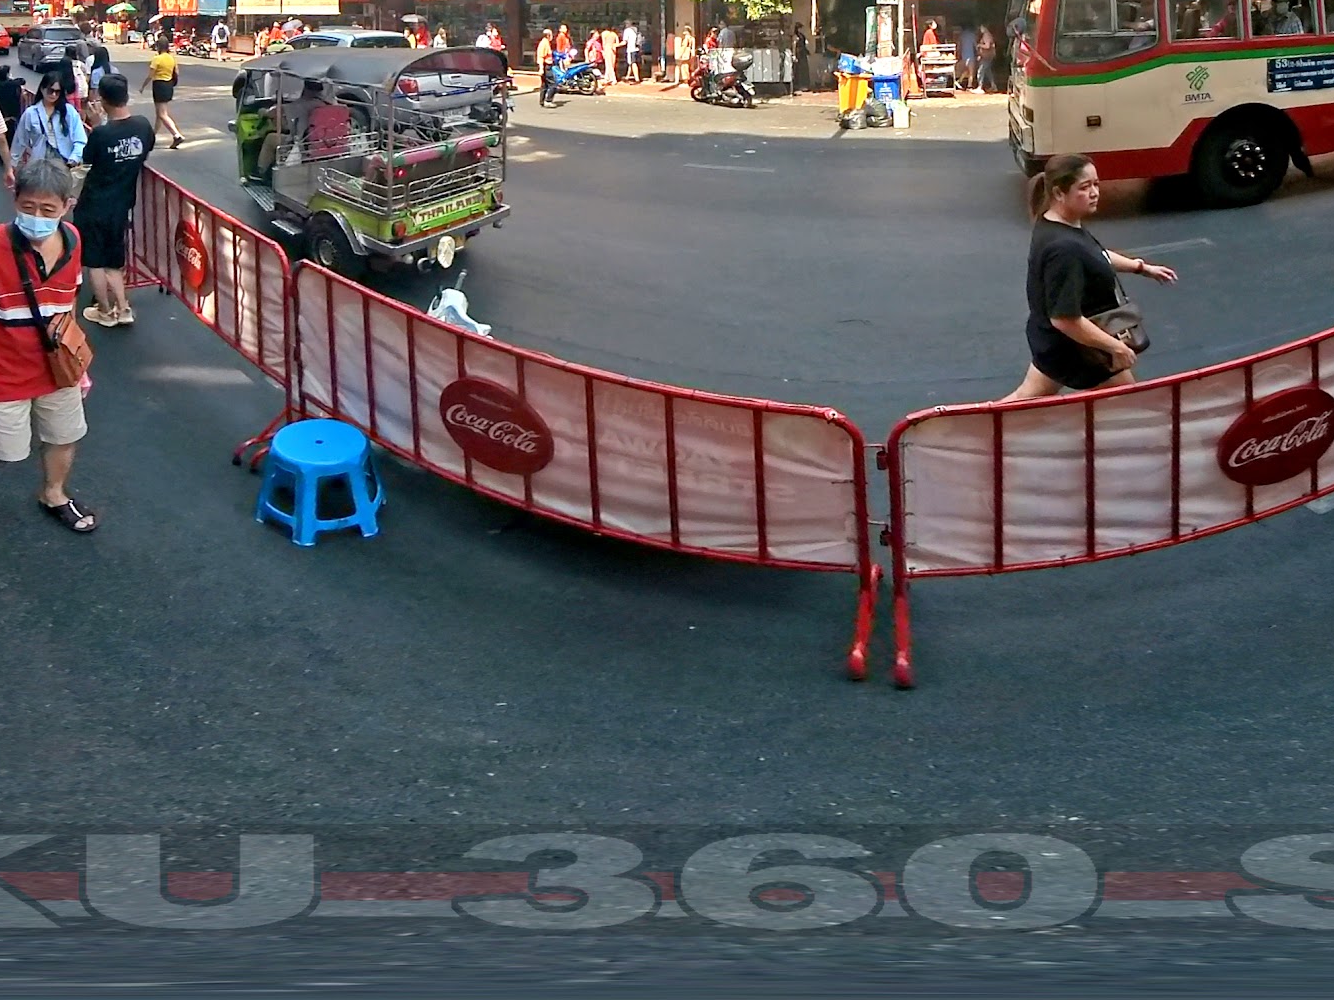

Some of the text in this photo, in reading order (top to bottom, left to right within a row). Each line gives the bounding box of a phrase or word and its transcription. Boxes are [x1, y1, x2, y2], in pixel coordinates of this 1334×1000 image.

[1274, 58, 1288, 69] 53
[1184, 92, 1212, 102] BMTA
[446, 403, 541, 454] Coca-Cola
[1227, 408, 1334, 468] Coca-Cola
